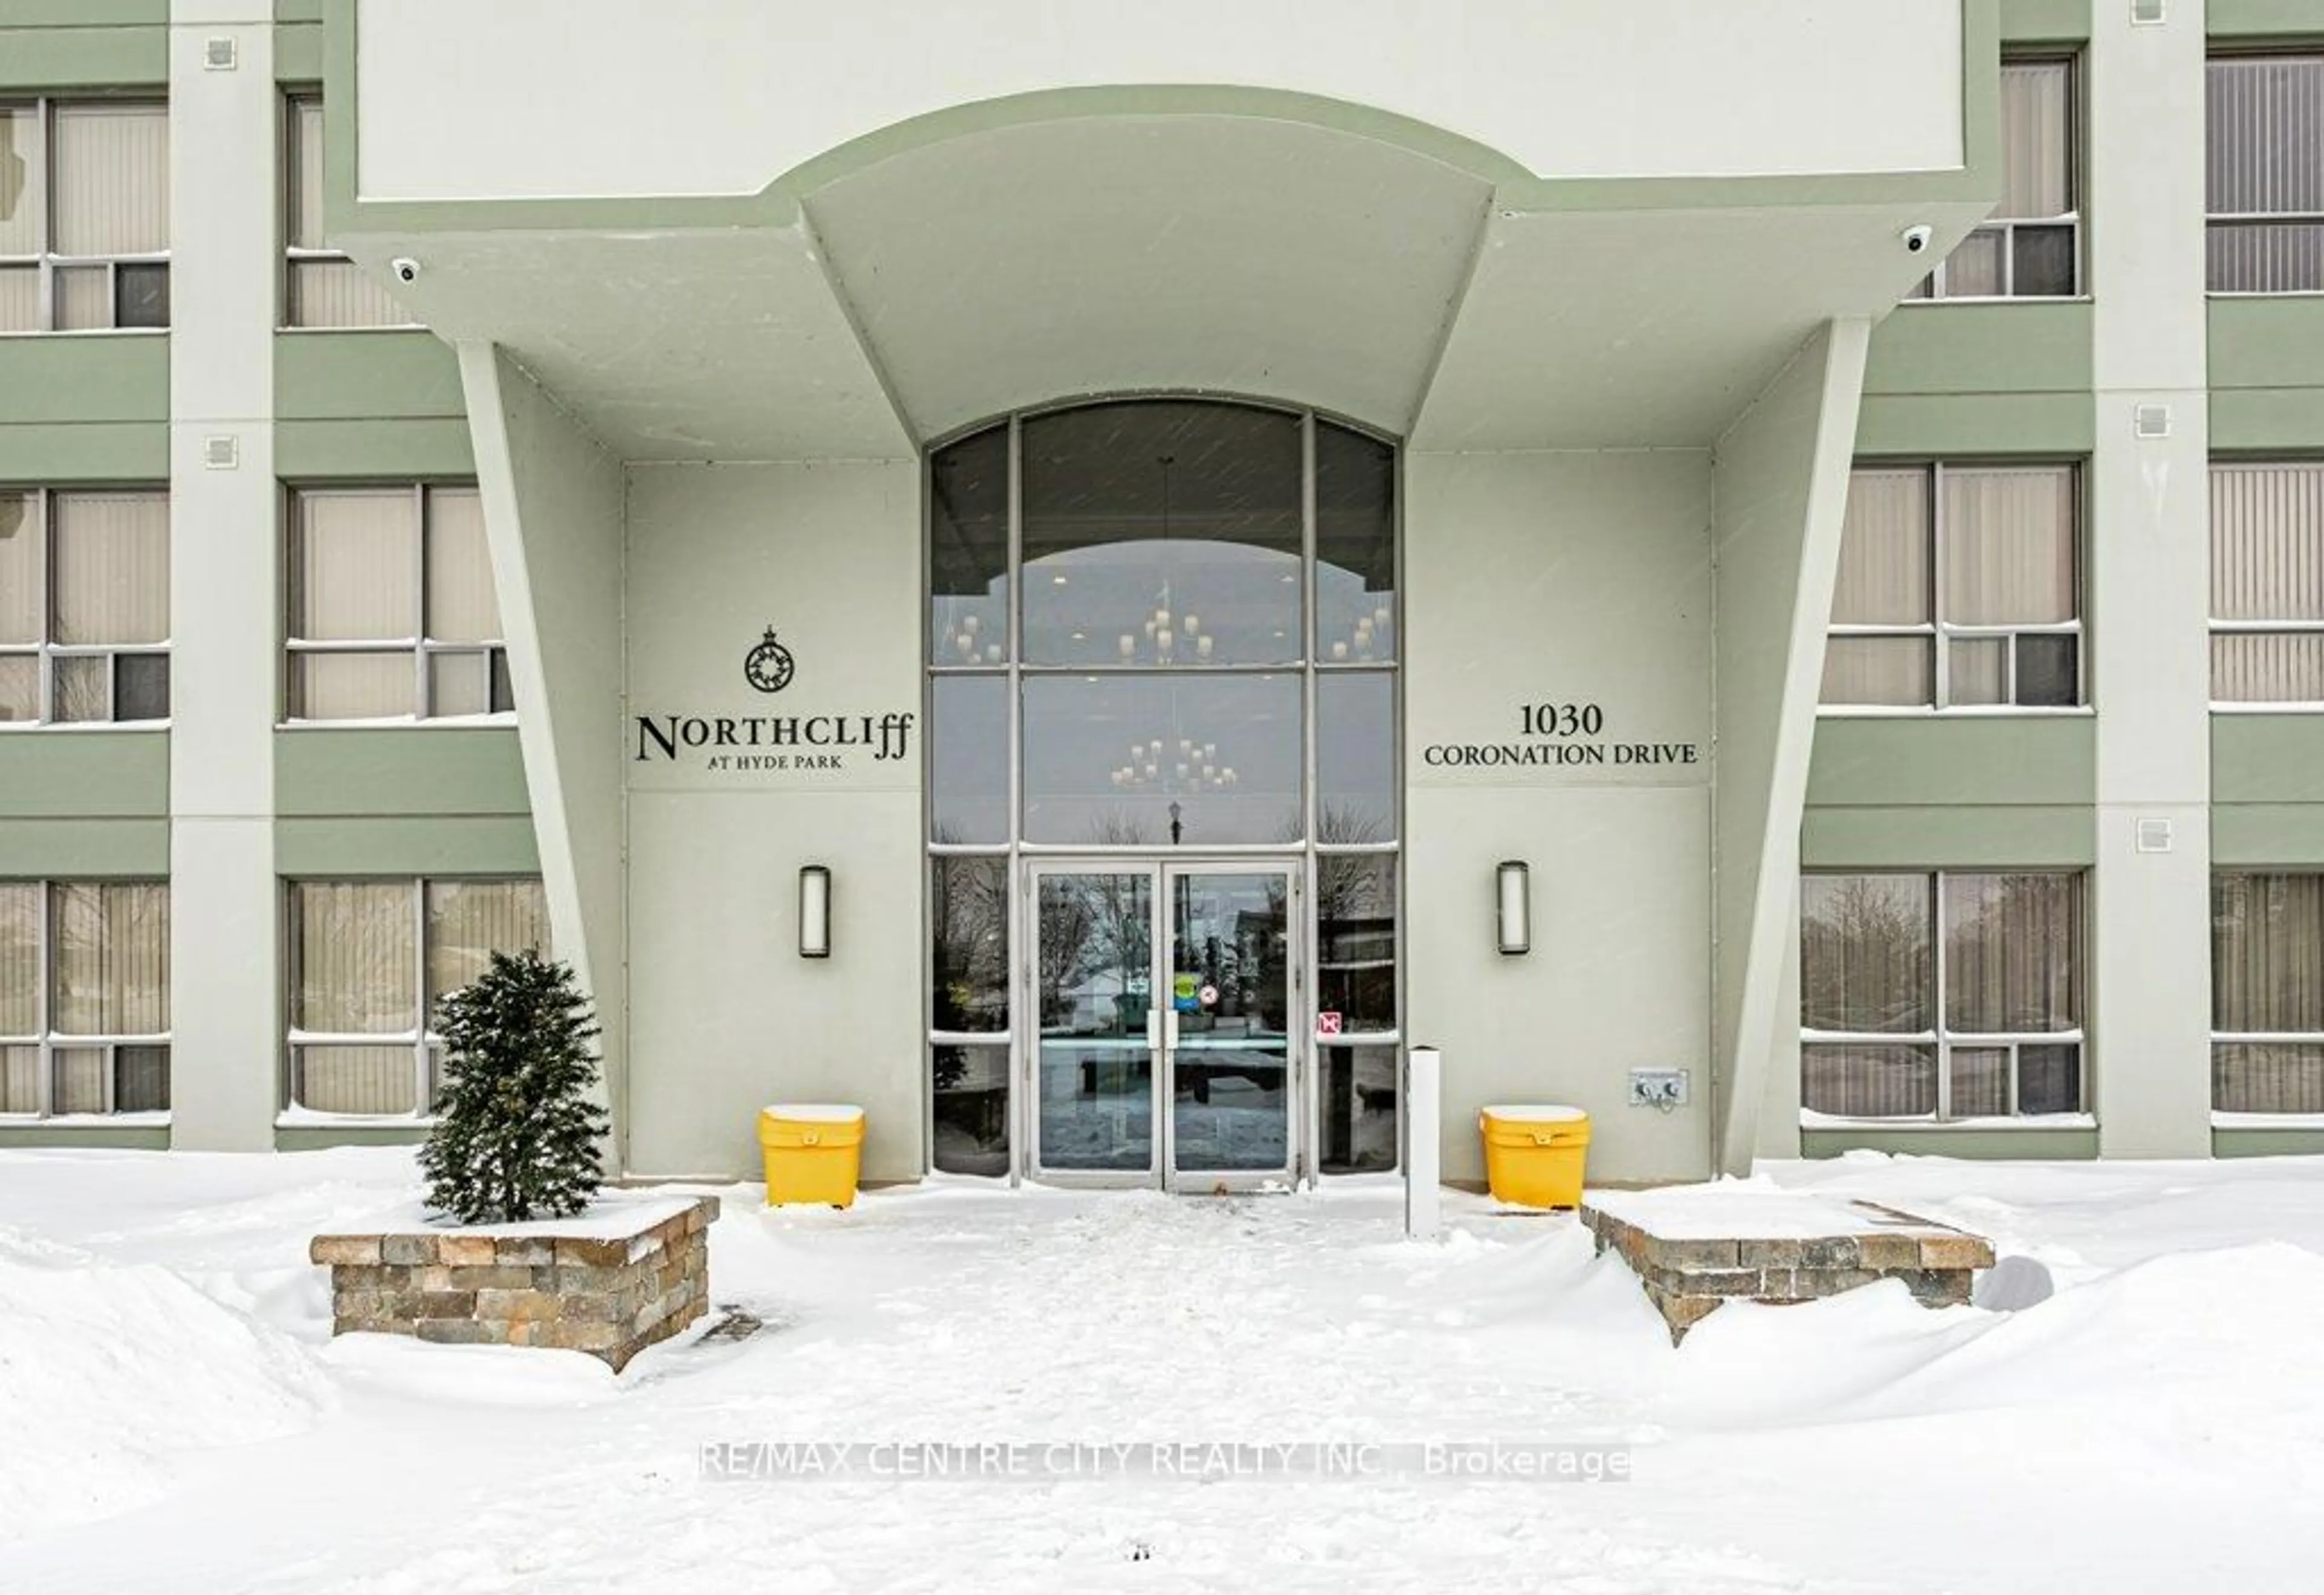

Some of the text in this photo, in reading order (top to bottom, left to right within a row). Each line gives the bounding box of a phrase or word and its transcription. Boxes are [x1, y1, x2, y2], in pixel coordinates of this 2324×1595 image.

[1520, 704, 1603, 736] 1030
[707, 755, 841, 770] AT HYDE PARK
[1425, 744, 1698, 765] CORONATION DRIVE
